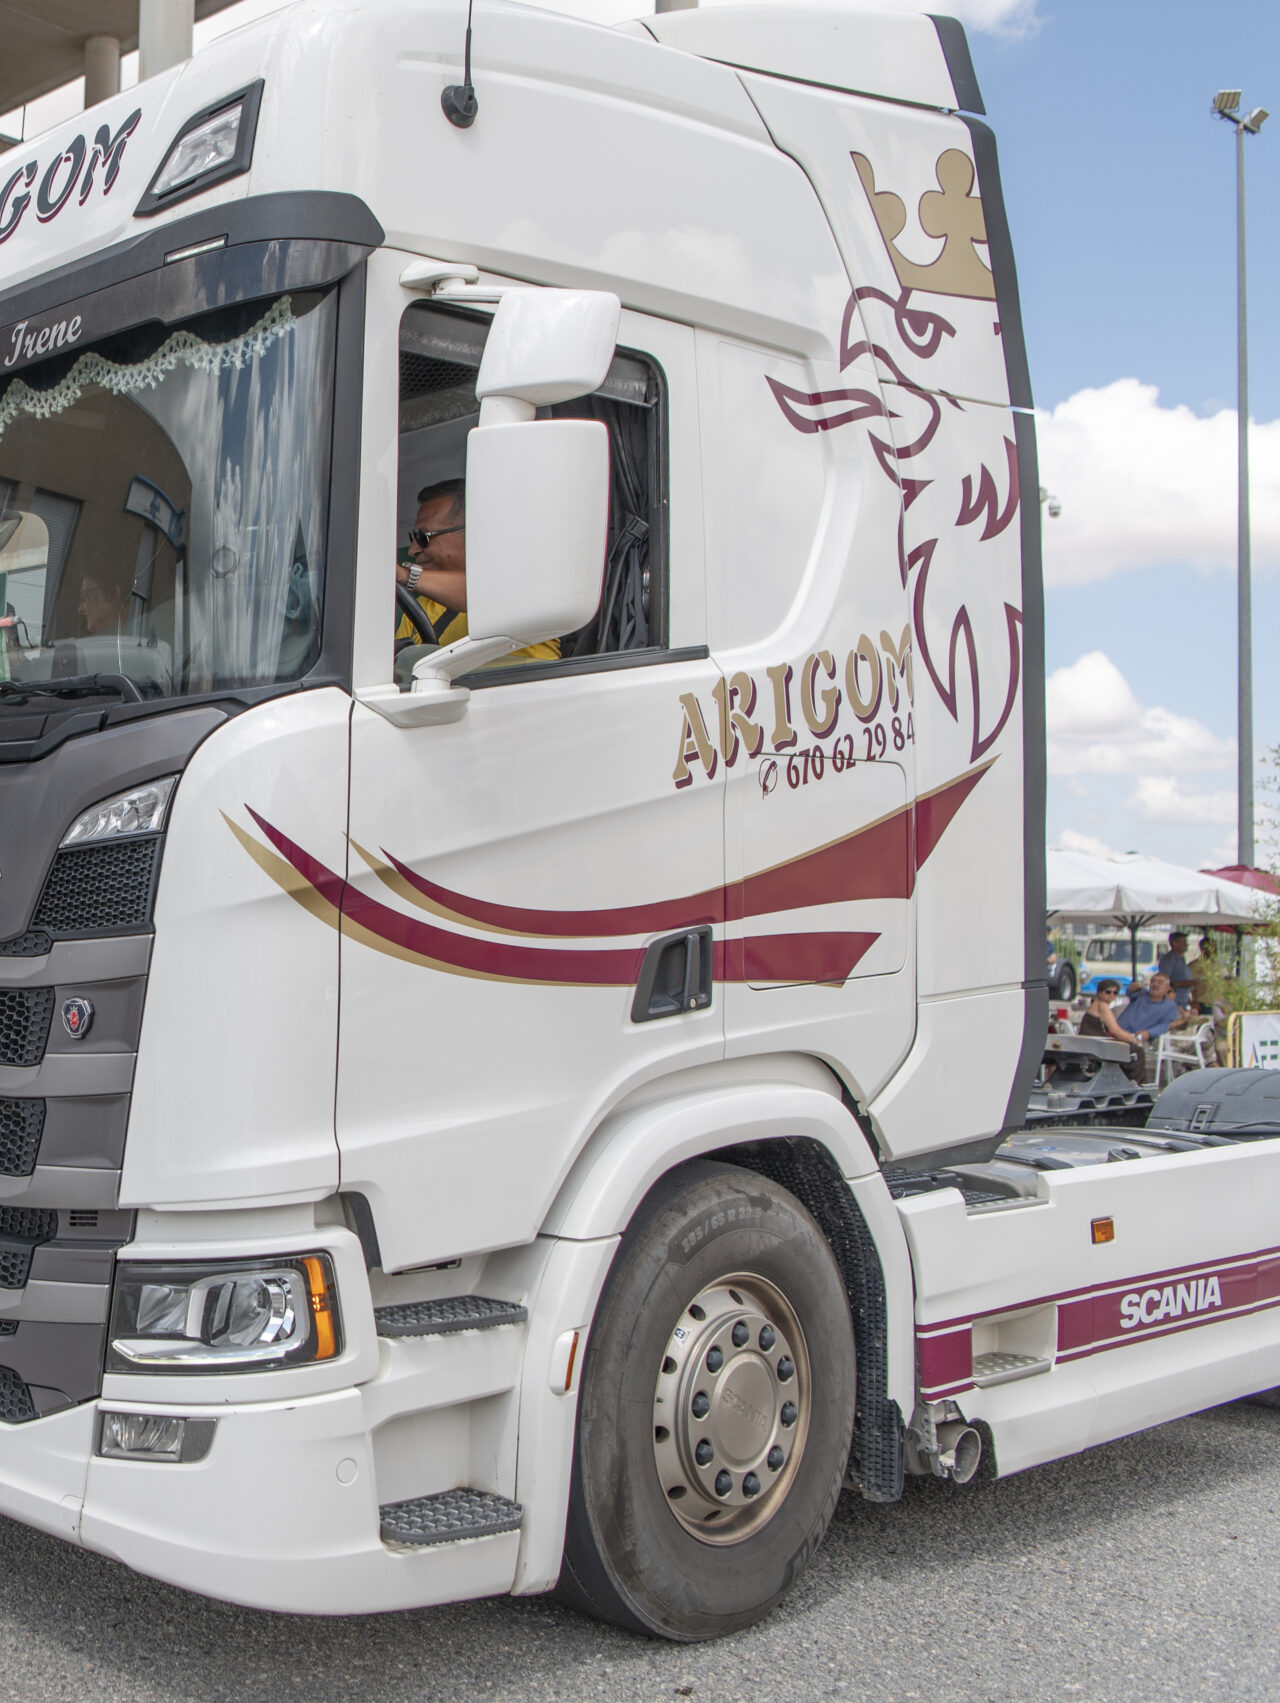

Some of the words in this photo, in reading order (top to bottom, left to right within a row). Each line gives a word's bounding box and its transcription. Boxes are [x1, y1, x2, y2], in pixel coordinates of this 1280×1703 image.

[4, 315, 82, 368] Irene
[672, 622, 914, 789] ARIGOM
[786, 744, 825, 790] 670
[832, 733, 857, 774] 62
[862, 722, 887, 763] 29
[1119, 1276, 1222, 1329] SCANIA
